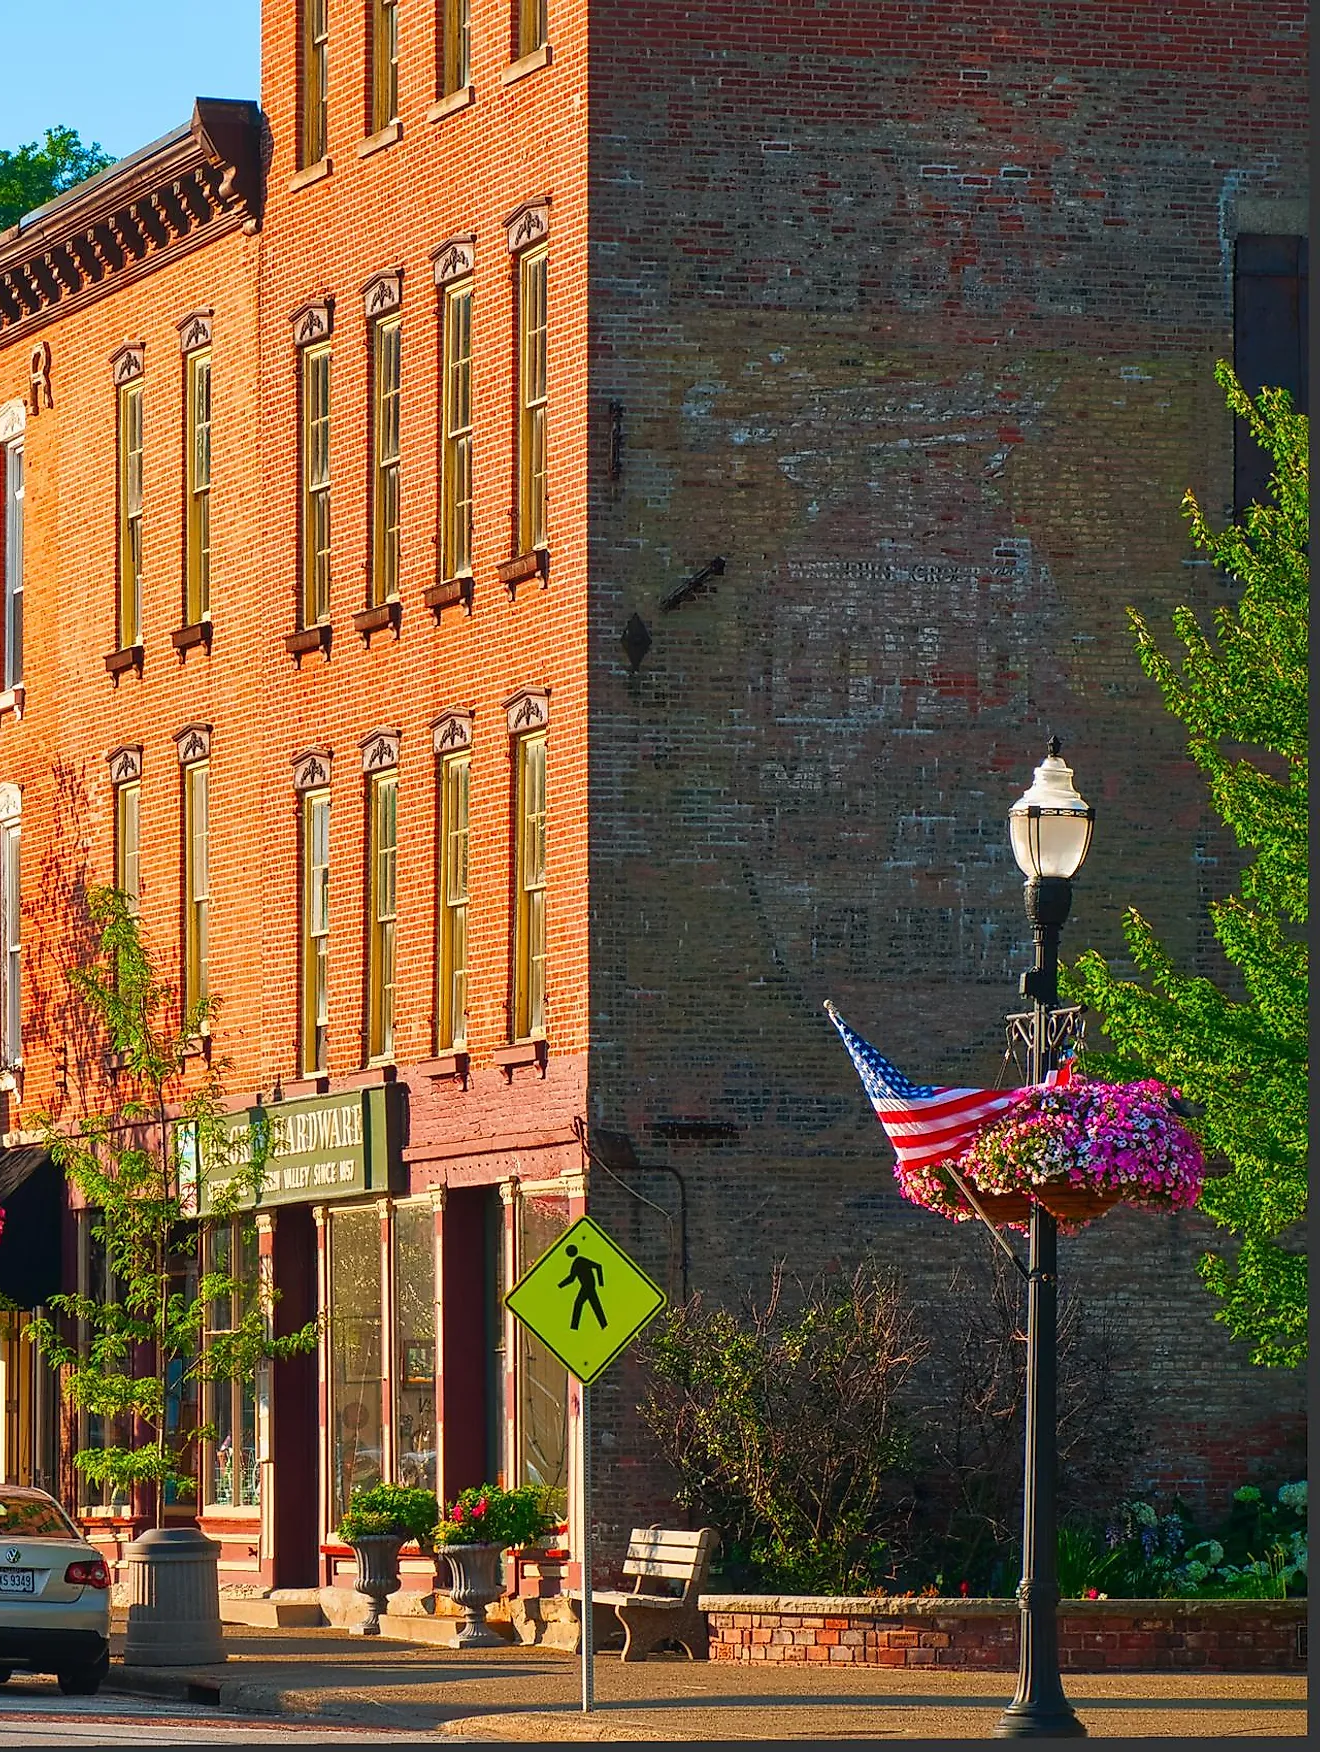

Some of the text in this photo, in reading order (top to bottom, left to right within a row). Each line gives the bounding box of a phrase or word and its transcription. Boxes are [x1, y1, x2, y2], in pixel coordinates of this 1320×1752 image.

[272, 1103, 364, 1157] HARDWARE
[283, 1165, 311, 1190] VALLEY
[313, 1161, 337, 1186] SINCE
[10, 1574, 31, 1587] 9349
